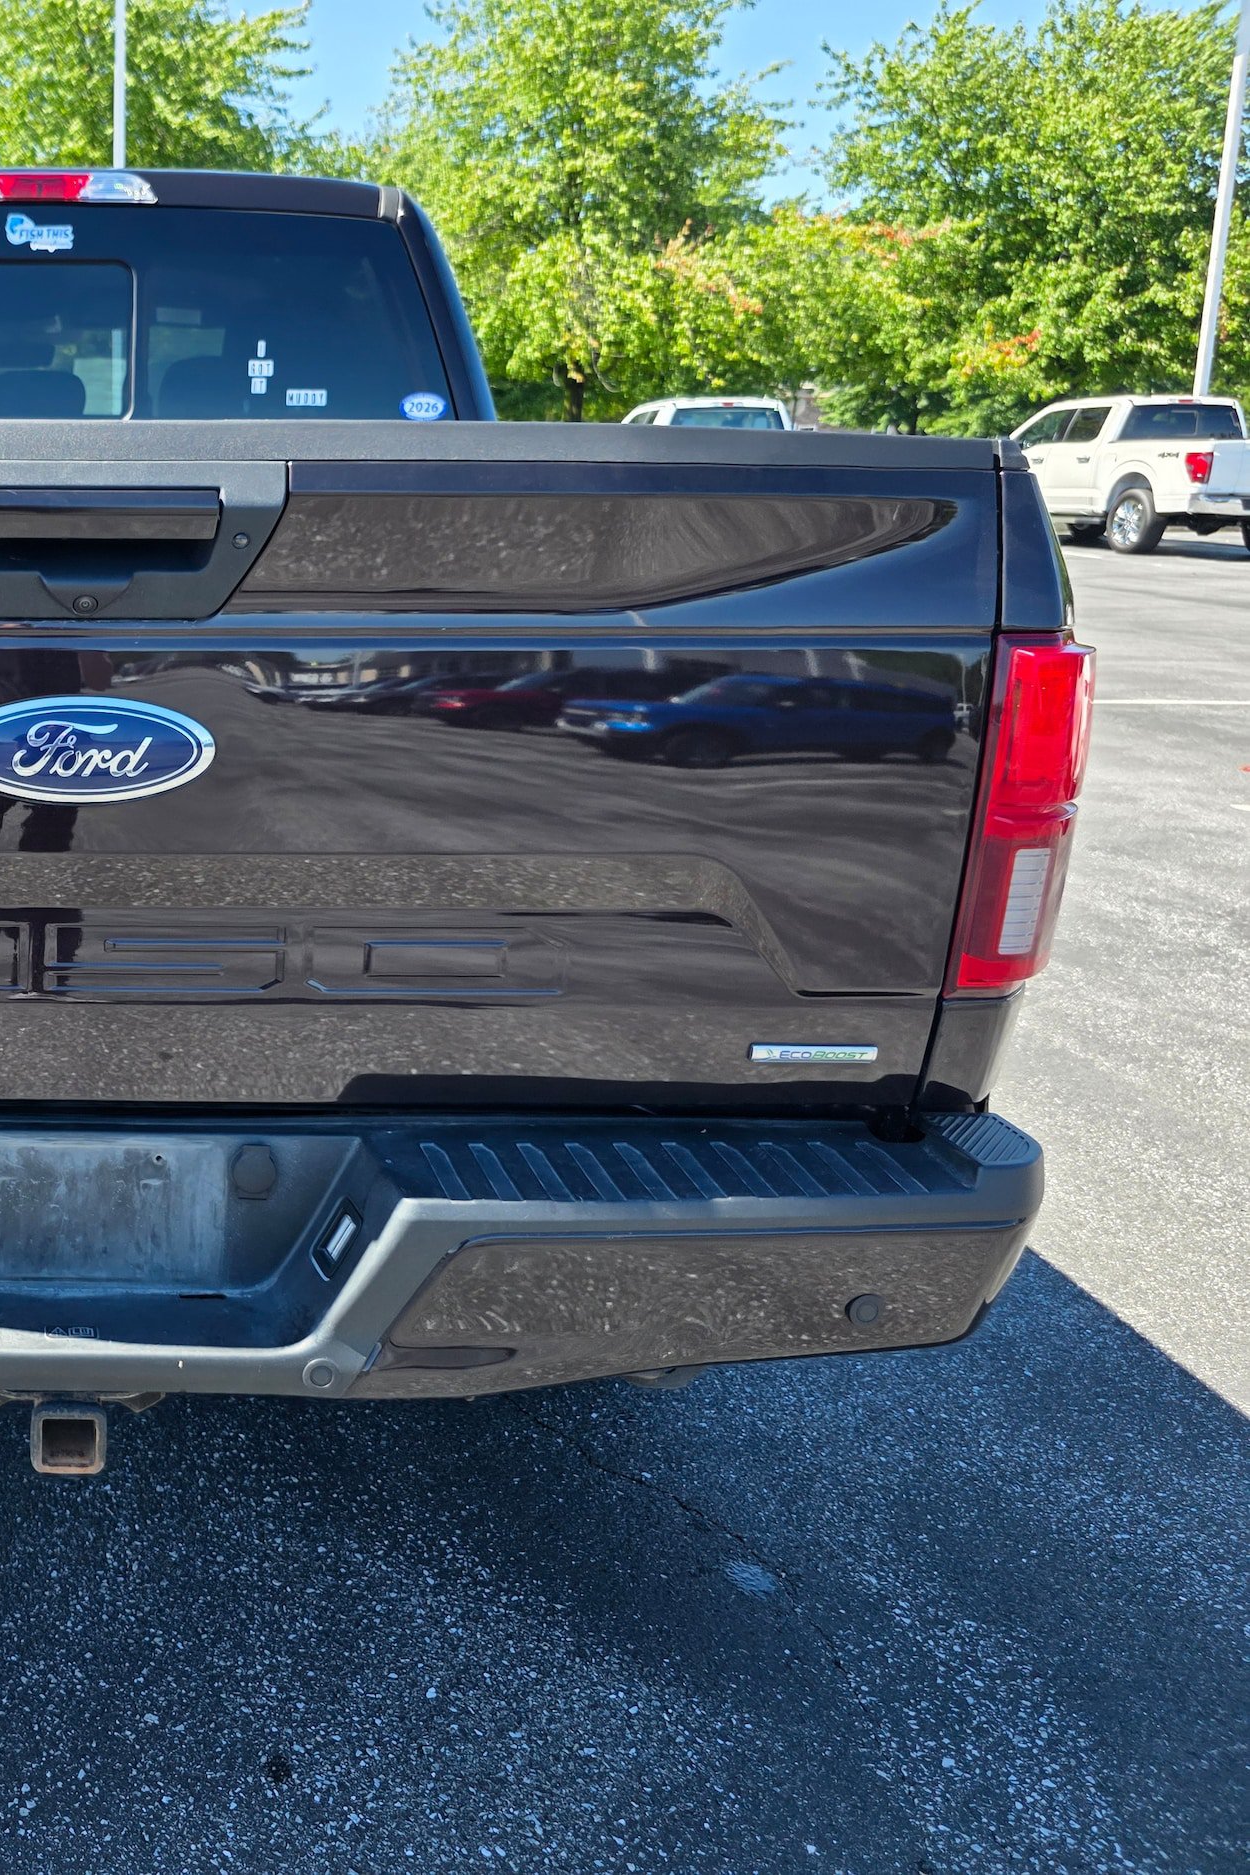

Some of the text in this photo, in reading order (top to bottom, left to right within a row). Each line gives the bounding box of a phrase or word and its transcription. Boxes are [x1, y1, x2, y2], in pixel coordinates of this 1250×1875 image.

[19, 228, 69, 240] FISH THIS
[288, 392, 324, 405] MUDDY
[408, 401, 439, 413] 2026
[12, 719, 153, 778] Ford
